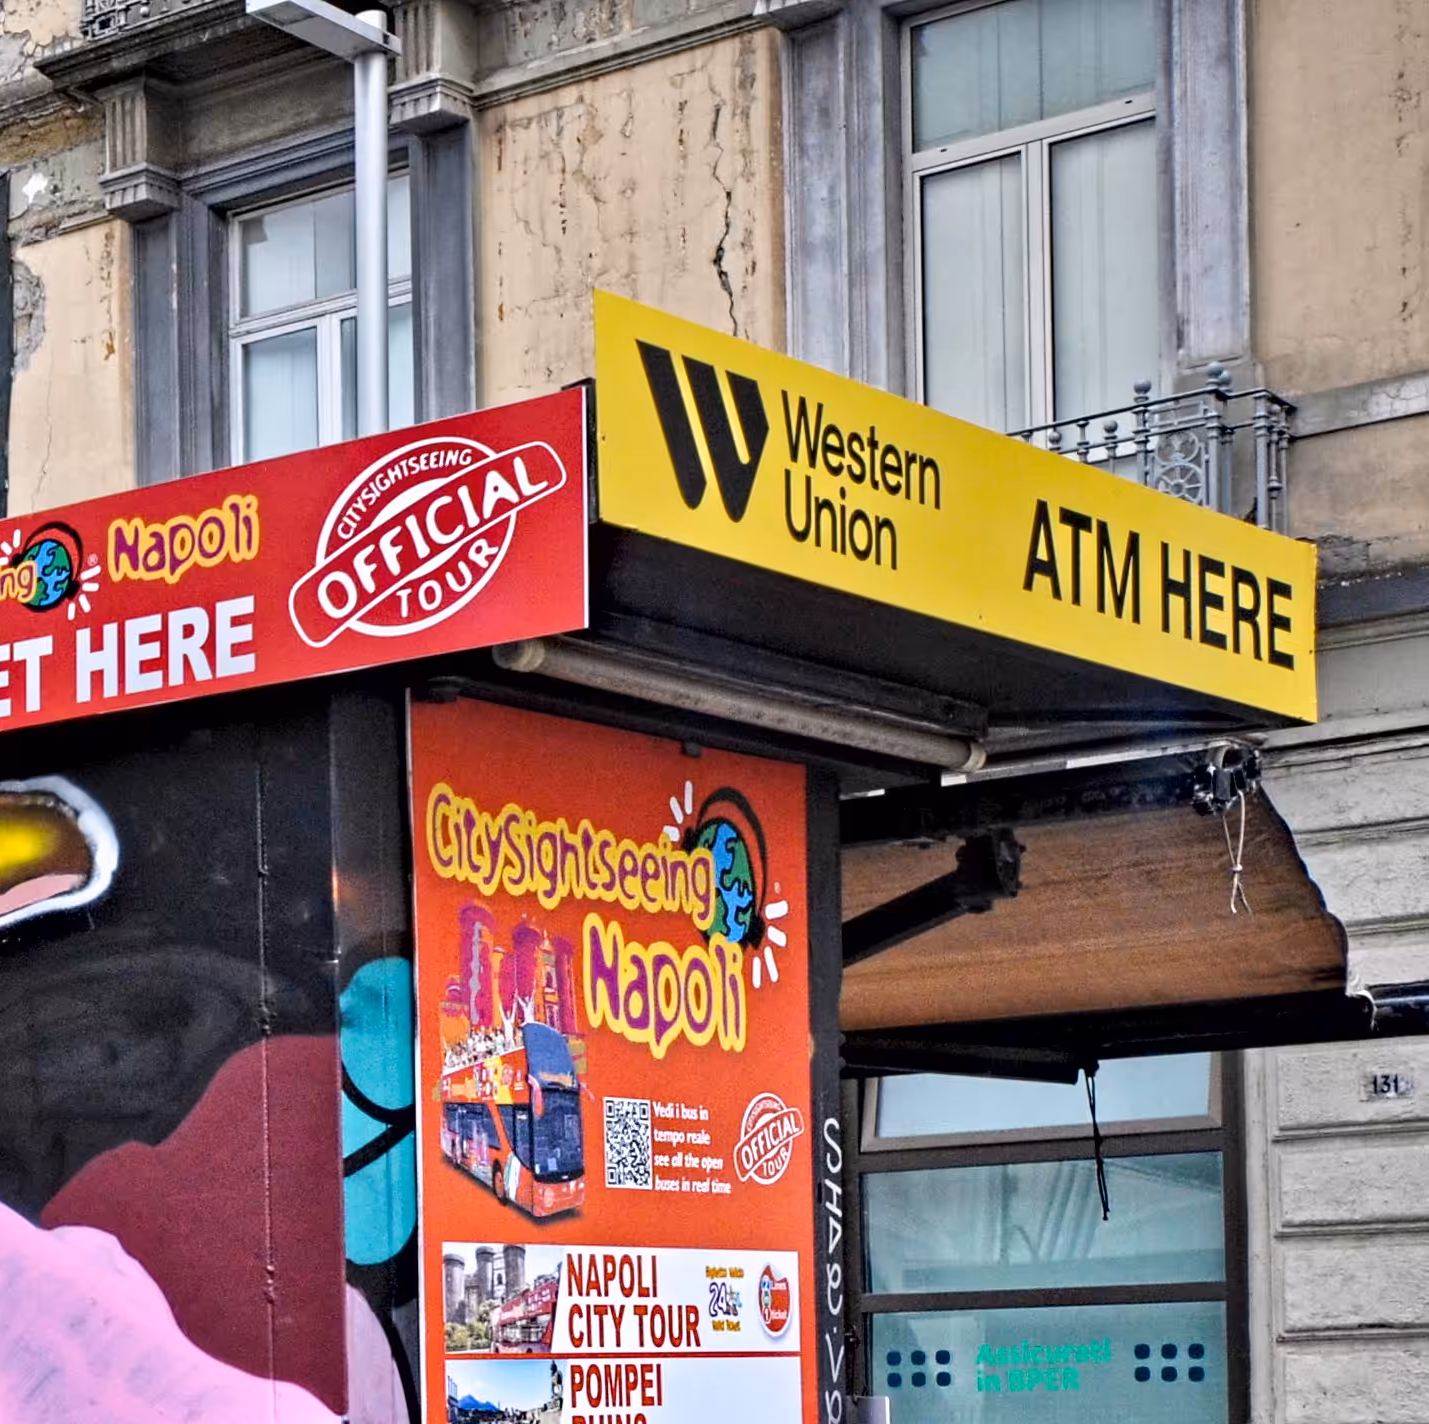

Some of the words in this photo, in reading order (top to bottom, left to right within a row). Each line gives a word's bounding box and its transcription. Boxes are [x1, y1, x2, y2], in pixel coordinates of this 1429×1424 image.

[780, 388, 942, 510] Western
[337, 447, 473, 540] CITYSIGHTSEEING
[108, 494, 259, 583] Napoli
[318, 460, 547, 618] OFFICIAL
[782, 474, 898, 571] Union
[398, 540, 498, 618] TOUR
[1023, 498, 1141, 626] ATM
[1160, 540, 1295, 671] HERE
[75, 596, 255, 703] HERE
[428, 784, 715, 930] CitySightseeing
[583, 913, 747, 1058] Napoli
[1373, 1073, 1398, 1094] 131
[652, 1101, 674, 1118] Vedi
[681, 1103, 698, 1120] bus
[699, 1105, 709, 1120] in
[654, 1128, 685, 1147] tempo
[685, 1152, 700, 1168] the
[701, 1156, 723, 1173] open
[742, 1113, 799, 1170] OFFICIAL
[763, 1147, 788, 1176] TOUR
[655, 1174, 679, 1190] buses
[682, 1177, 690, 1192] in
[691, 1178, 710, 1192] real
[711, 1179, 731, 1194] time
[567, 1253, 659, 1298] NAPOLI
[568, 1304, 623, 1348] CITY
[638, 1304, 701, 1348] TOUR
[976, 1337, 1111, 1366] Assicurati
[571, 1363, 663, 1407] POMPEI
[977, 1370, 1001, 1392] in
[1008, 1367, 1081, 1392] BPER
